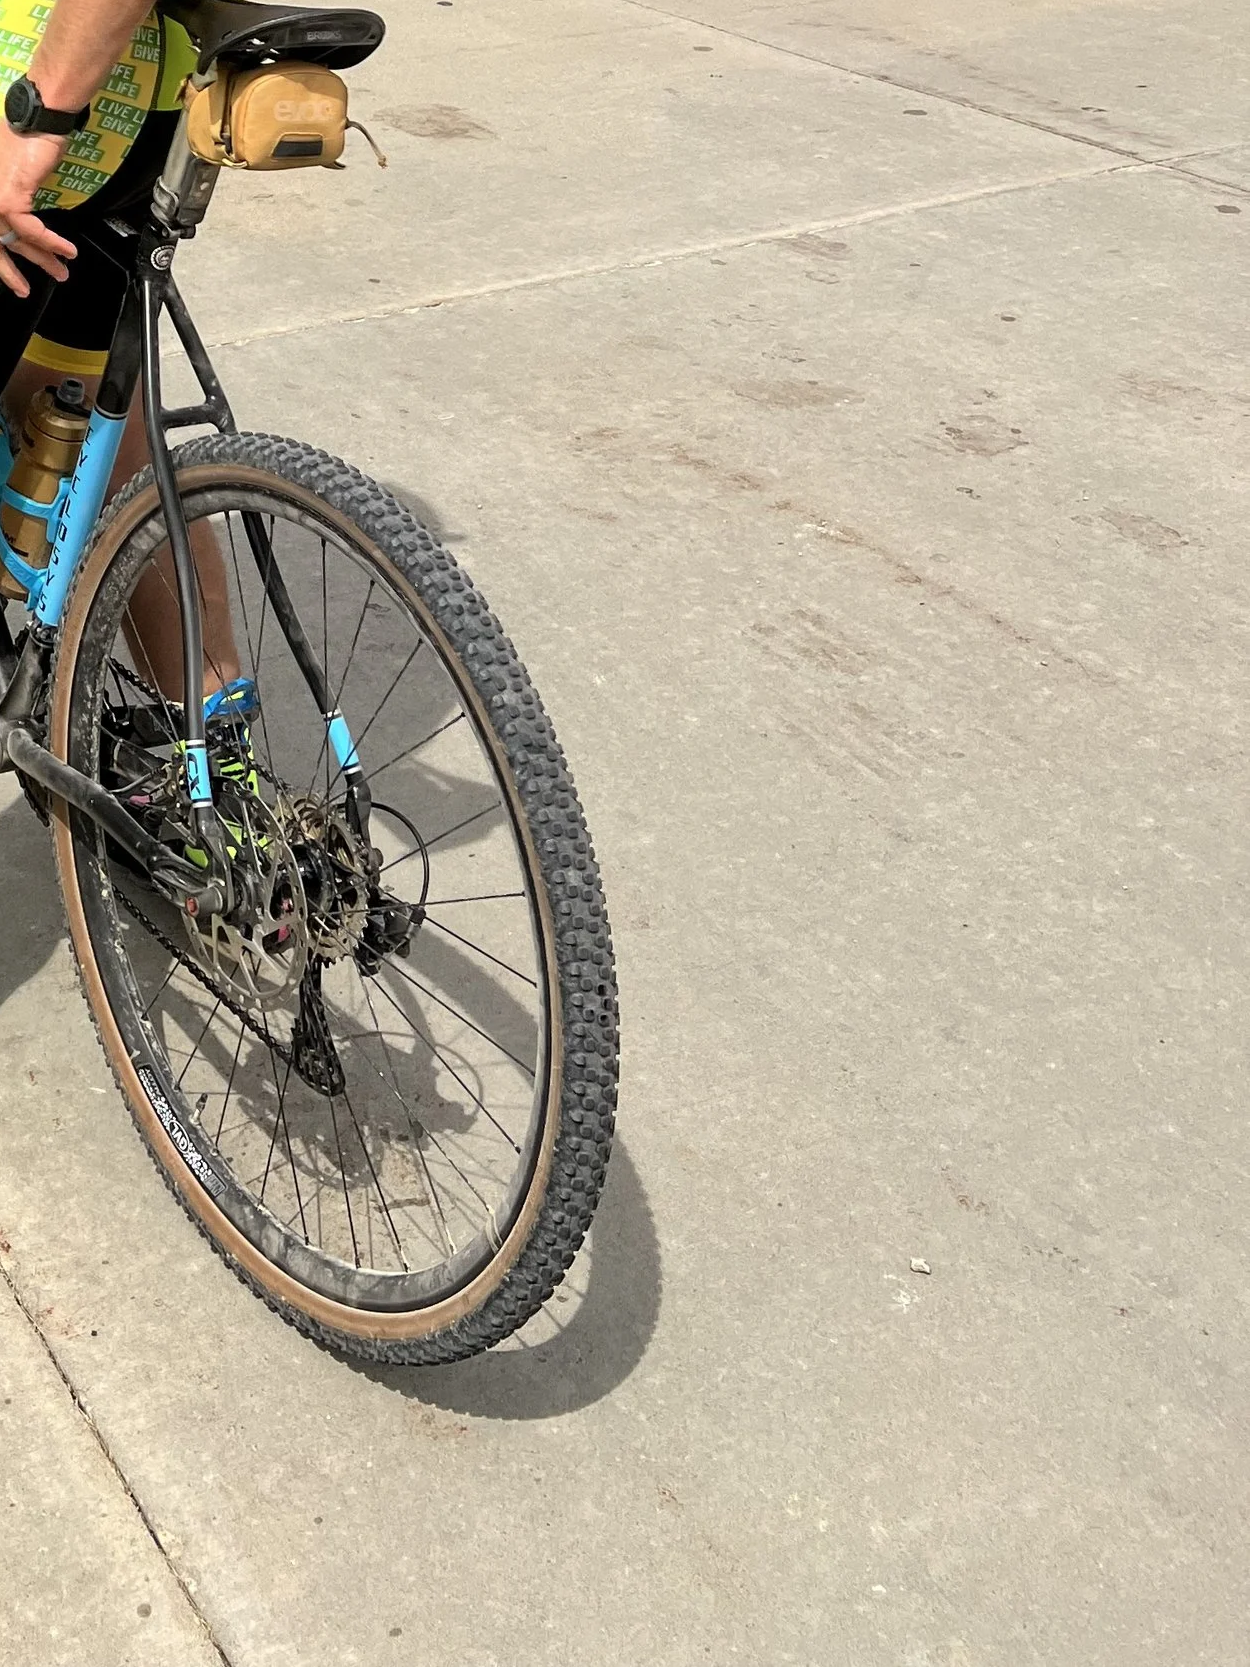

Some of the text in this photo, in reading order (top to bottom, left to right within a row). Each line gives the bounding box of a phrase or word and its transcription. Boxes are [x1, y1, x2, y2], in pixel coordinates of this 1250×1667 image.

[0, 29, 35, 50] LIFE
[133, 44, 160, 62] GIVE
[106, 81, 138, 98] LIFE
[97, 99, 129, 119] LIVE
[101, 116, 135, 136] GIVE
[68, 143, 102, 162] LIFE
[58, 161, 94, 182] LIVE
[61, 178, 99, 196] GIVE
